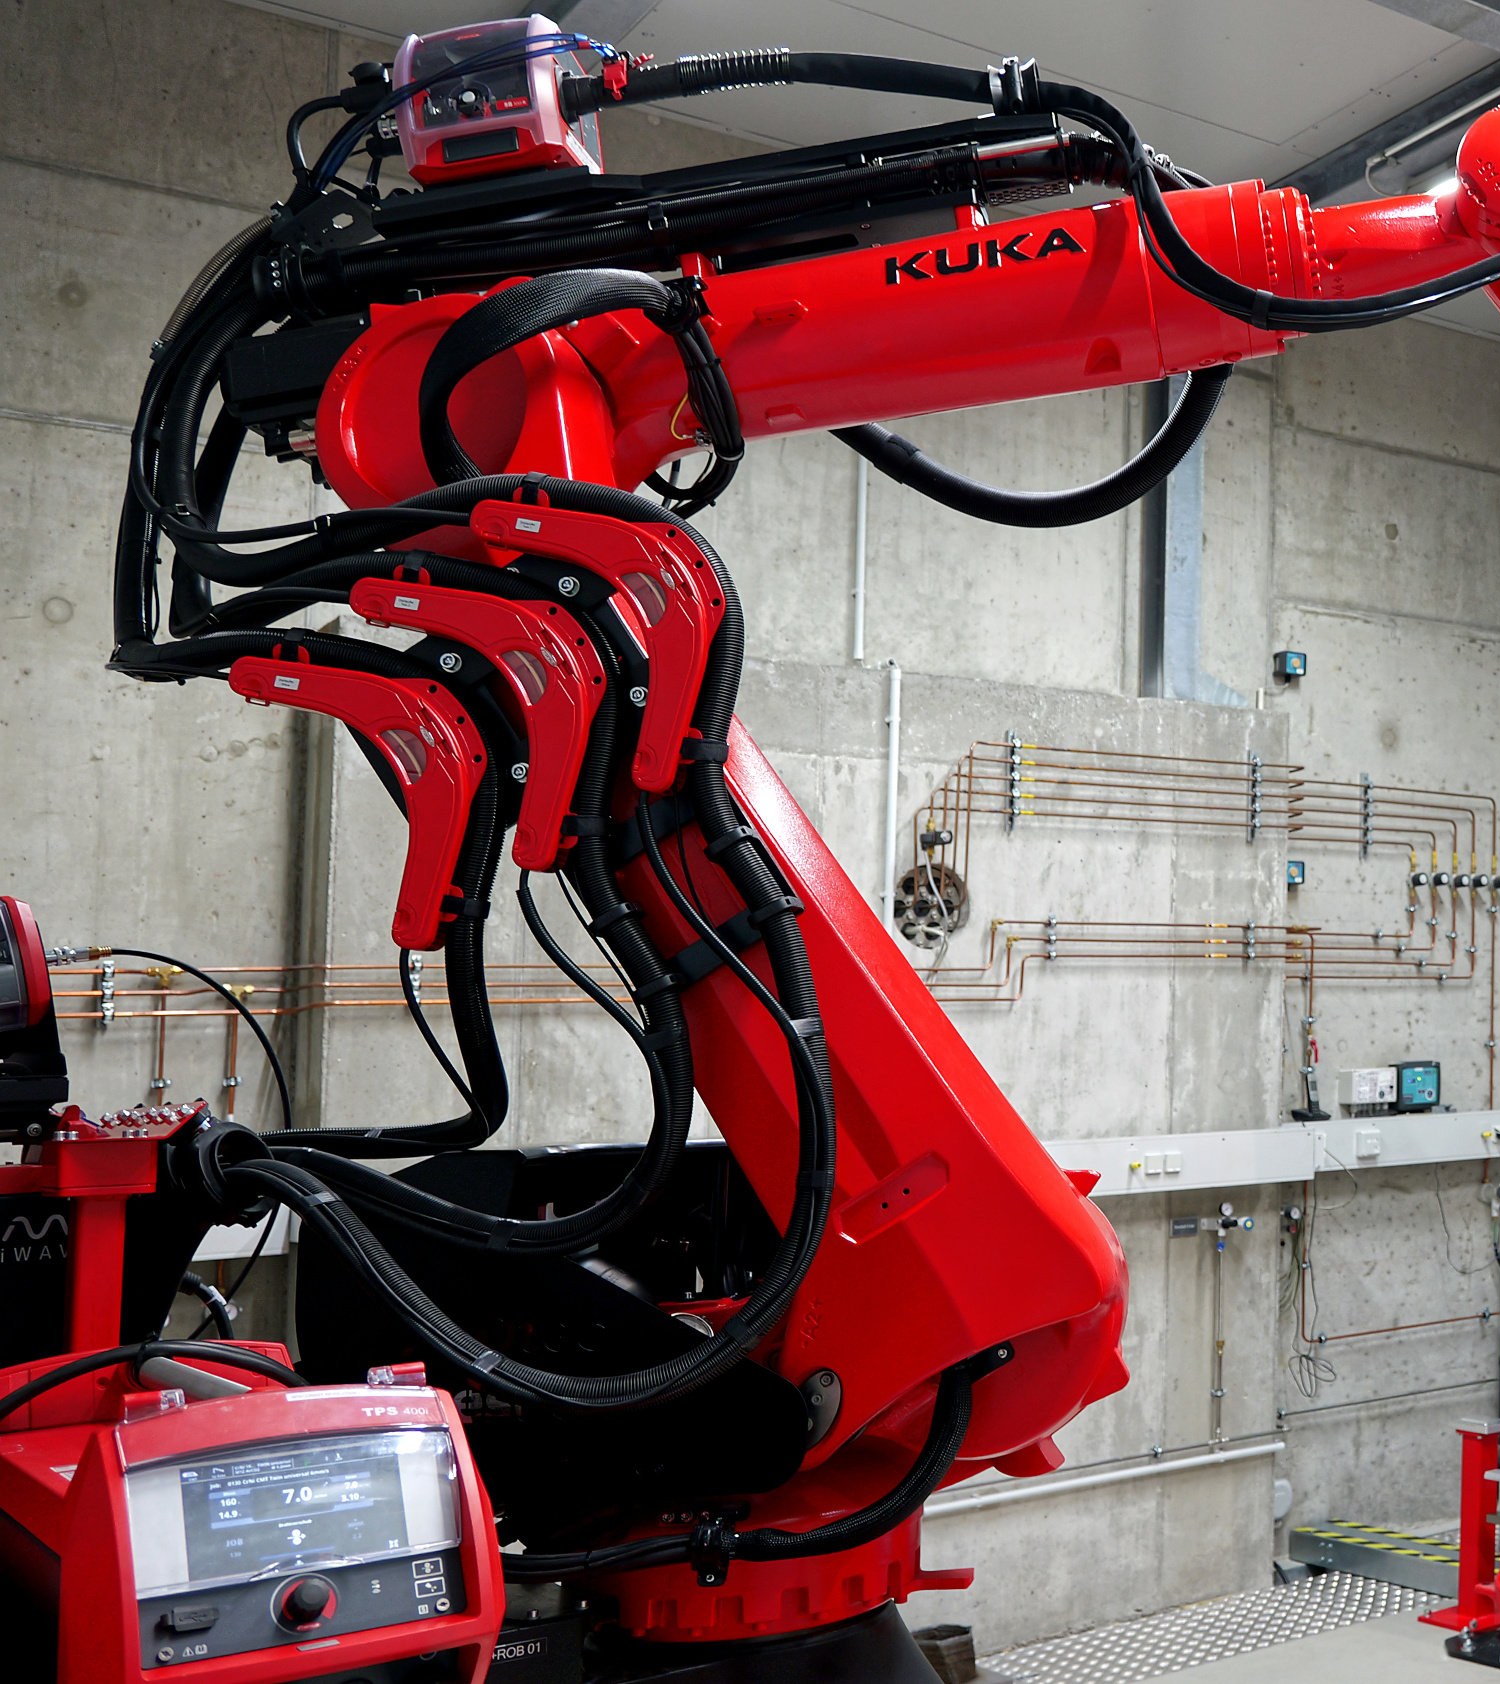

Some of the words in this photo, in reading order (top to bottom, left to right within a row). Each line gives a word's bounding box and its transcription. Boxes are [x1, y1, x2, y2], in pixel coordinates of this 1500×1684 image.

[886, 227, 1087, 285] KUKA
[0, 1244, 68, 1263] iWAV
[362, 1407, 398, 1416] TPS
[403, 1407, 429, 1415] 400i
[282, 1486, 312, 1504] 7.0
[220, 1498, 237, 1507] 160
[219, 1510, 238, 1520] 14.9
[527, 1642, 541, 1654] 01
